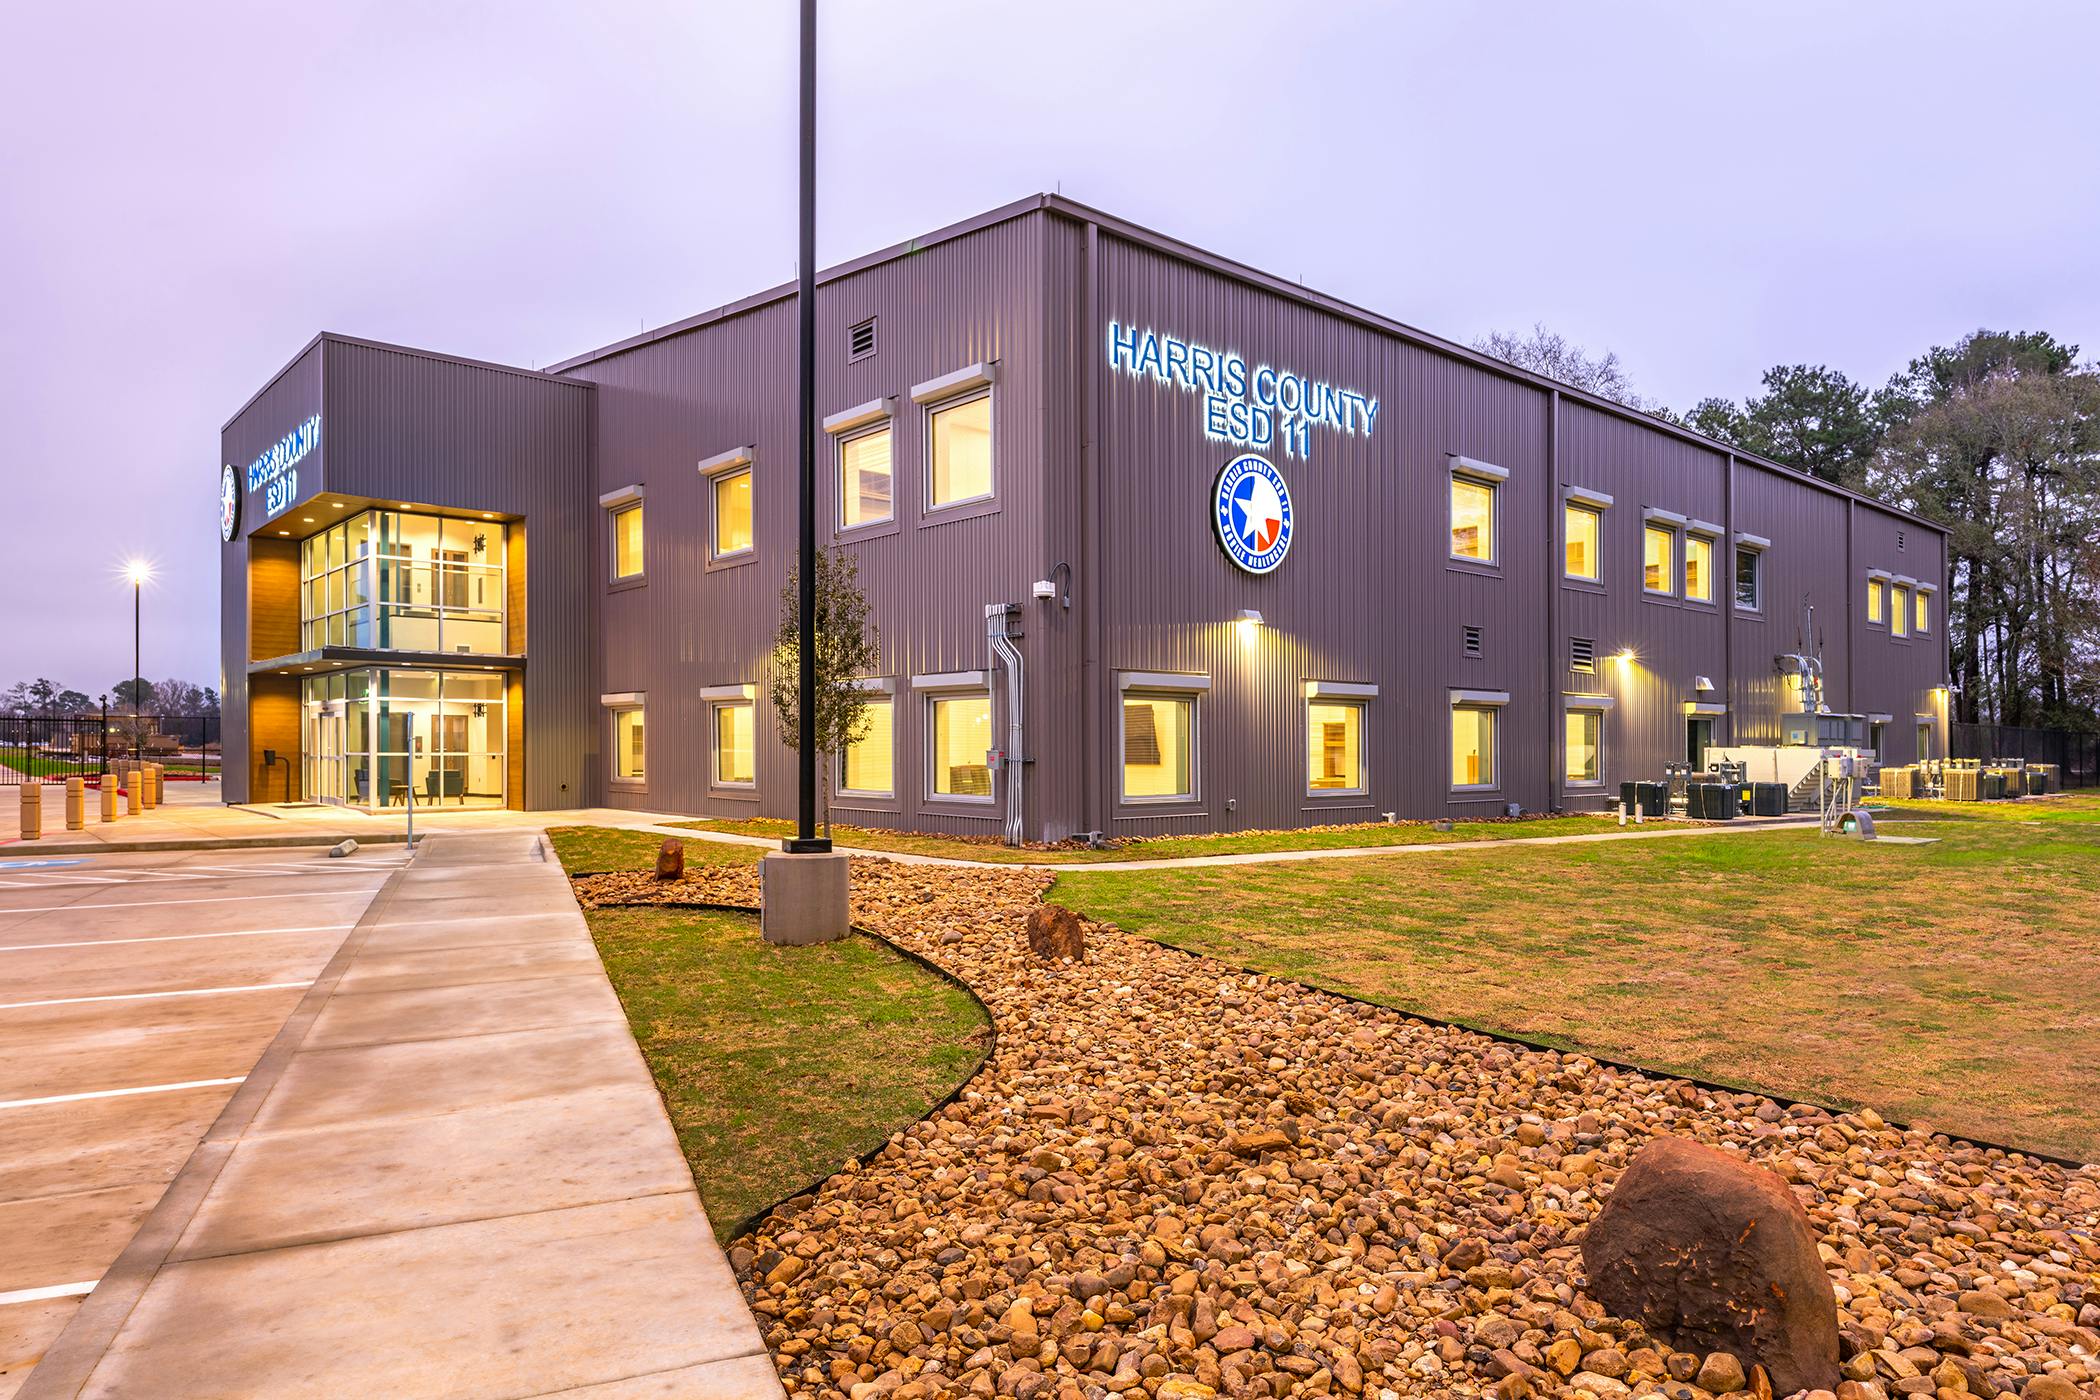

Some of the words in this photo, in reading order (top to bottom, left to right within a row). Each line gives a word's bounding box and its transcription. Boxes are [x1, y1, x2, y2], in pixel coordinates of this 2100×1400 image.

[1110, 322, 1247, 397] HARRIS
[1255, 368, 1379, 434] COUNTY
[1207, 395, 1273, 444] ESD
[1284, 416, 1310, 458] 11
[1221, 464, 1243, 500] HARRIS
[1243, 460, 1273, 479] COUNTY
[1272, 476, 1285, 499] ESD
[1222, 524, 1246, 561] MOBILE
[1248, 534, 1288, 568] HEALTHCARE
